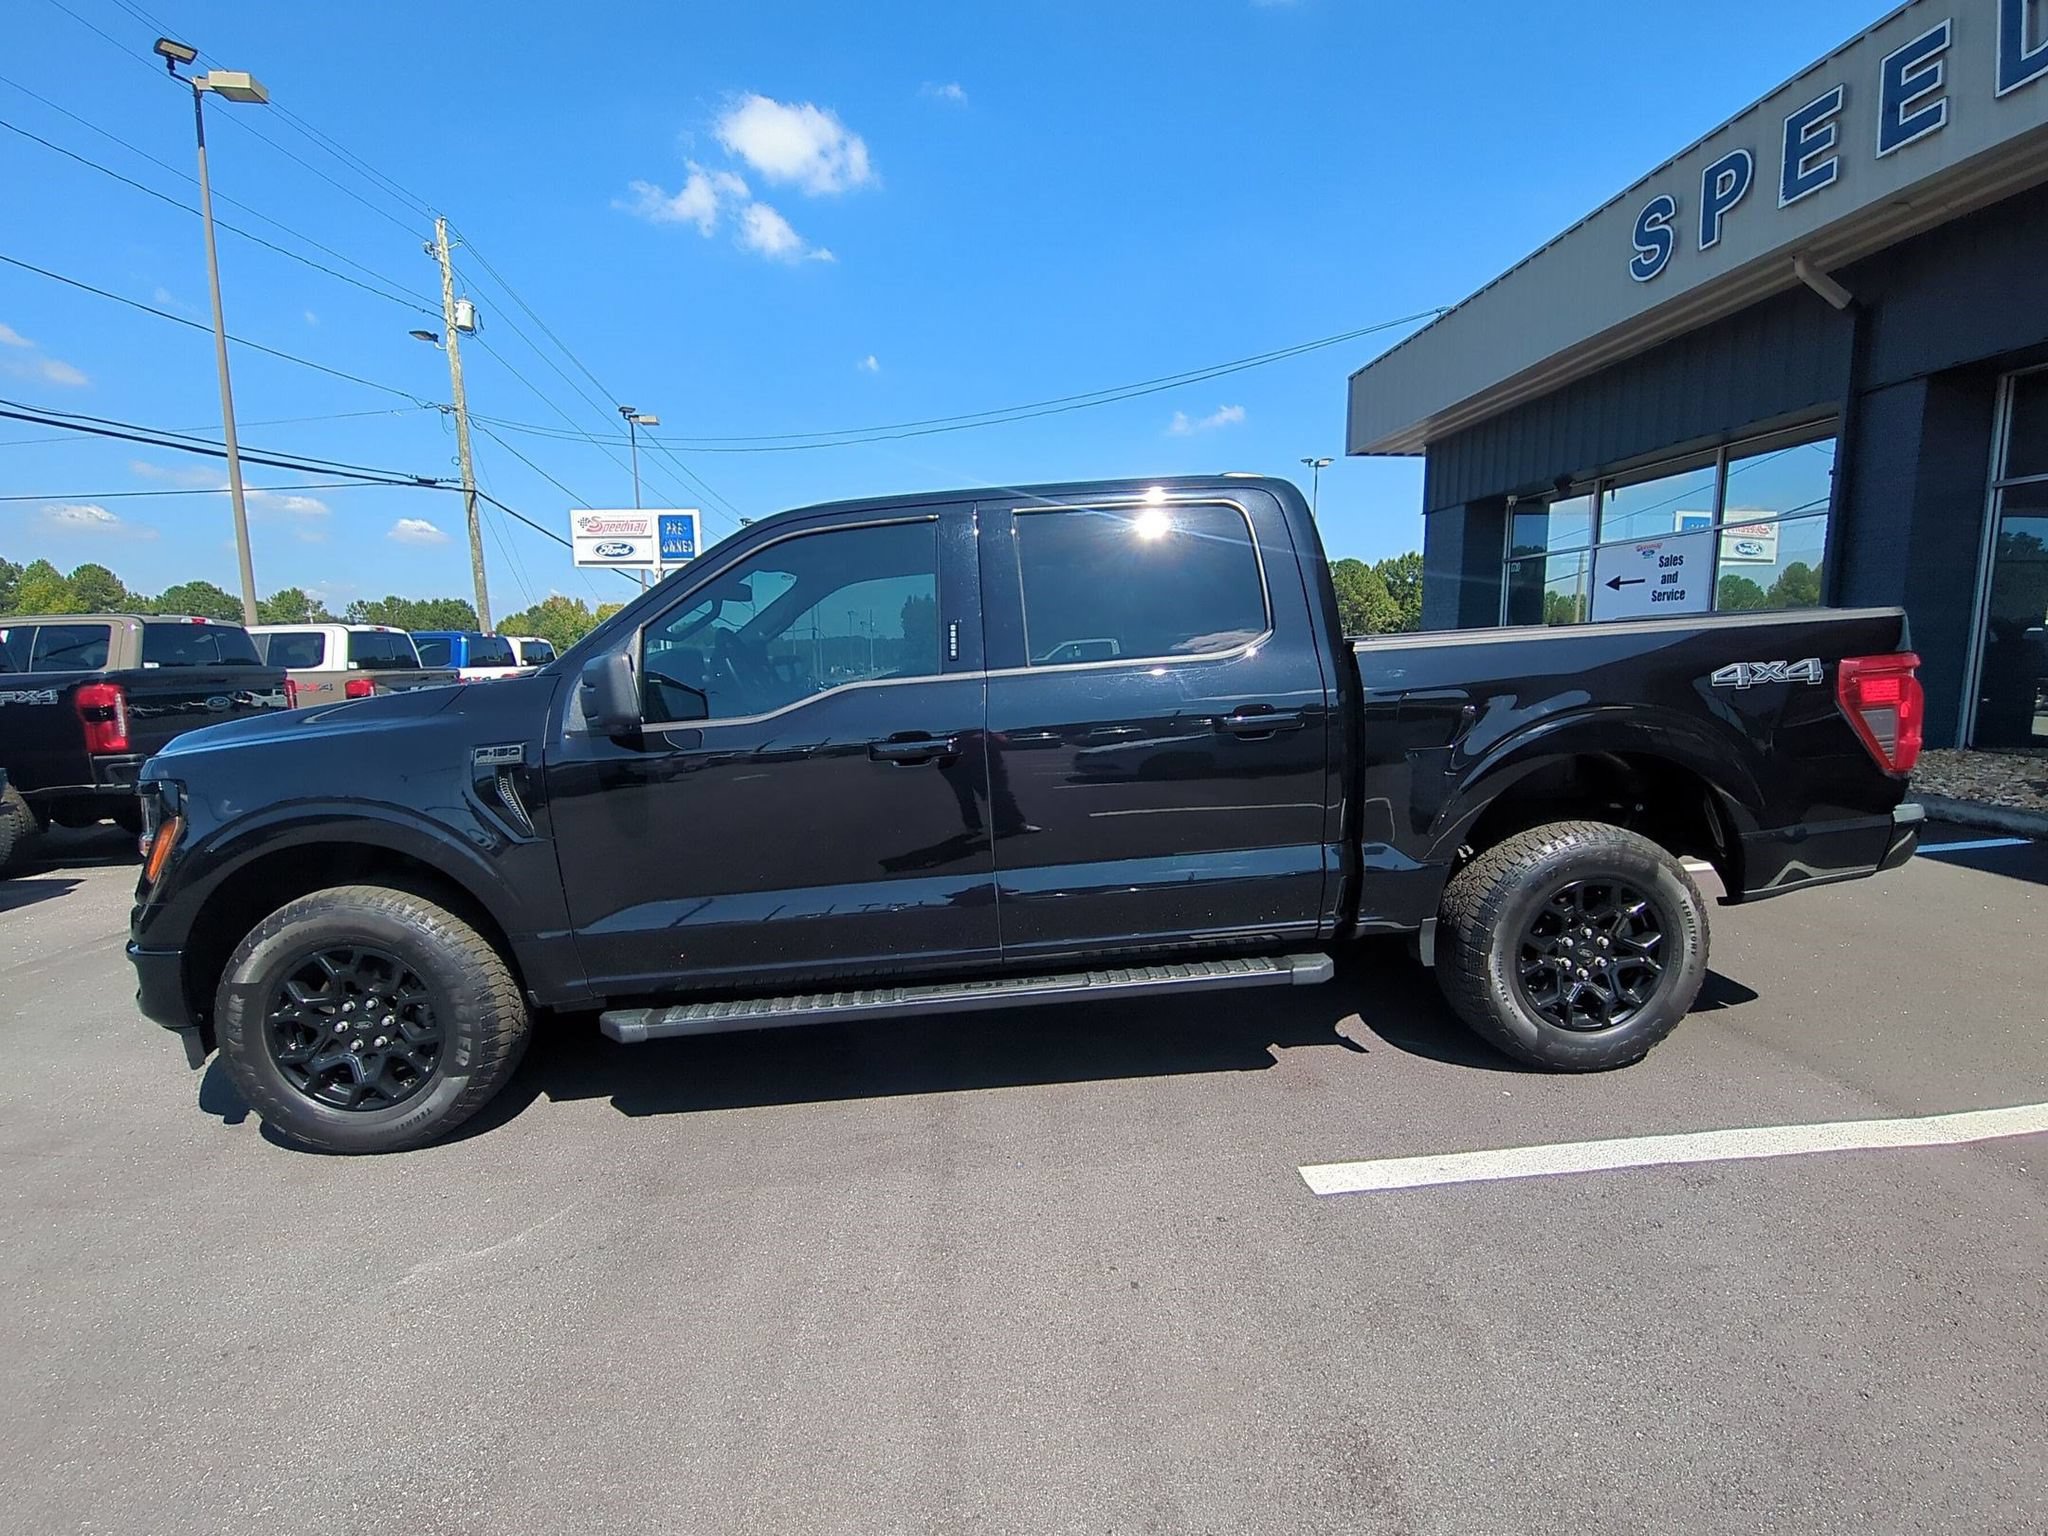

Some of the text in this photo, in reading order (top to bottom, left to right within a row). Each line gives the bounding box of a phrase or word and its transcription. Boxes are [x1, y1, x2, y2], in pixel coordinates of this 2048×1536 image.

[585, 516, 648, 534] Speedway
[598, 543, 631, 556] Ford
[662, 540, 693, 553] OWNED
[1658, 554, 1684, 568] Sales
[1660, 571, 1679, 585] and
[1651, 589, 1686, 602] Service
[475, 747, 521, 761] F-150
